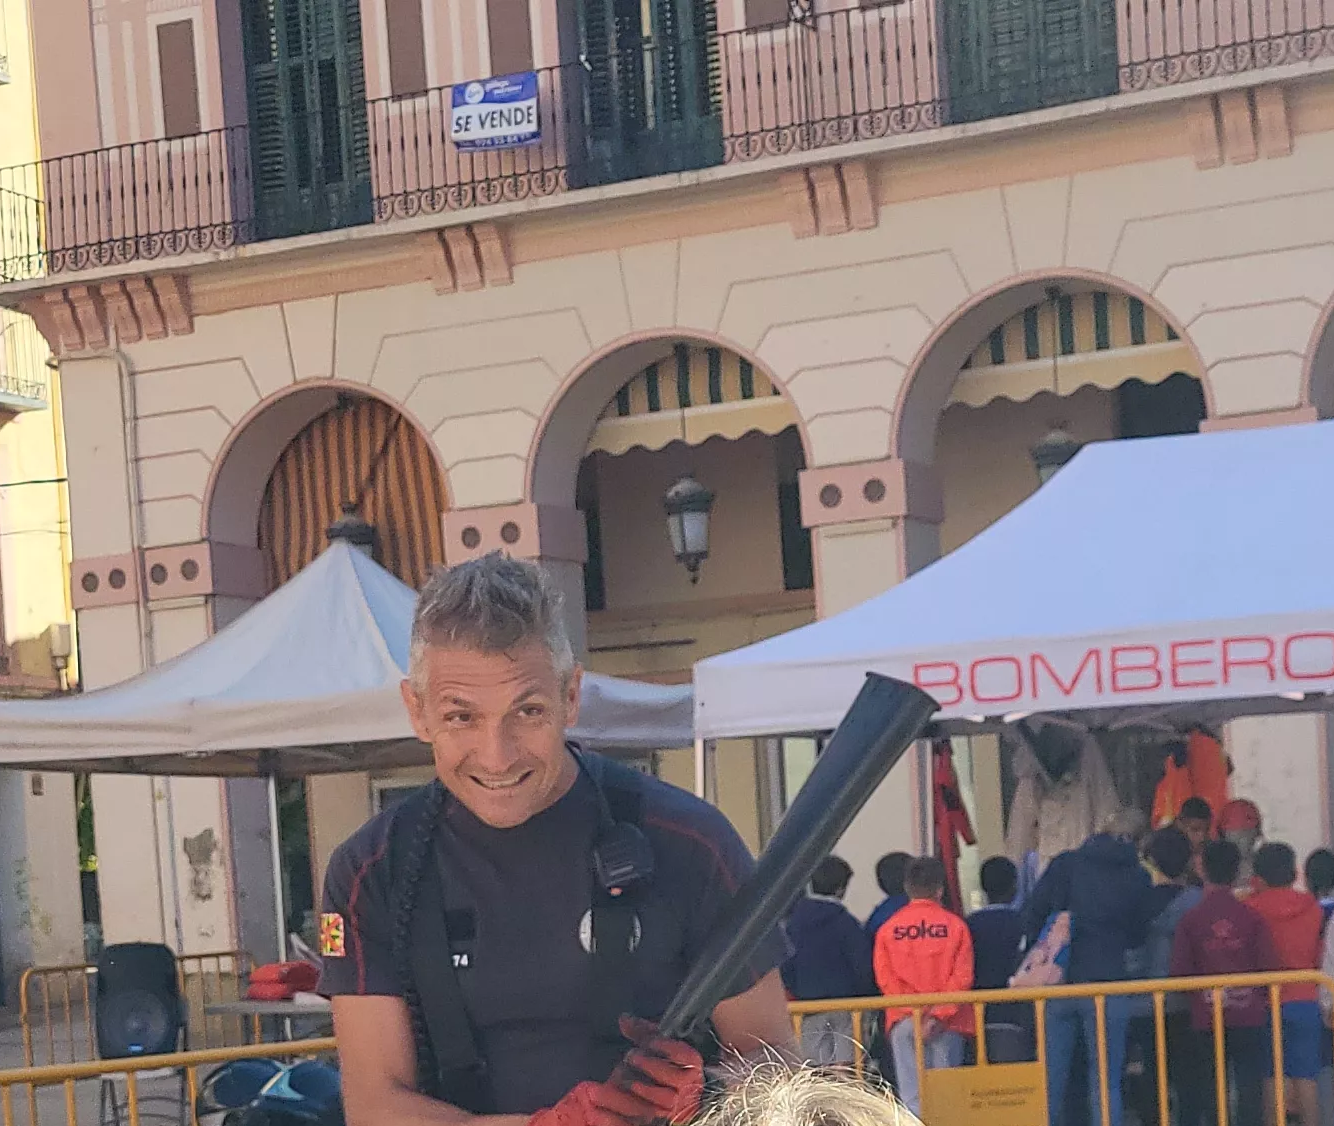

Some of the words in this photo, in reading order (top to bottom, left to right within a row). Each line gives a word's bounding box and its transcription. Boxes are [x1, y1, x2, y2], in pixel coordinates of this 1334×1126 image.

[453, 115, 472, 134] SE
[478, 104, 534, 130] VENDE
[893, 919, 948, 940] soka
[452, 954, 469, 968] 74
